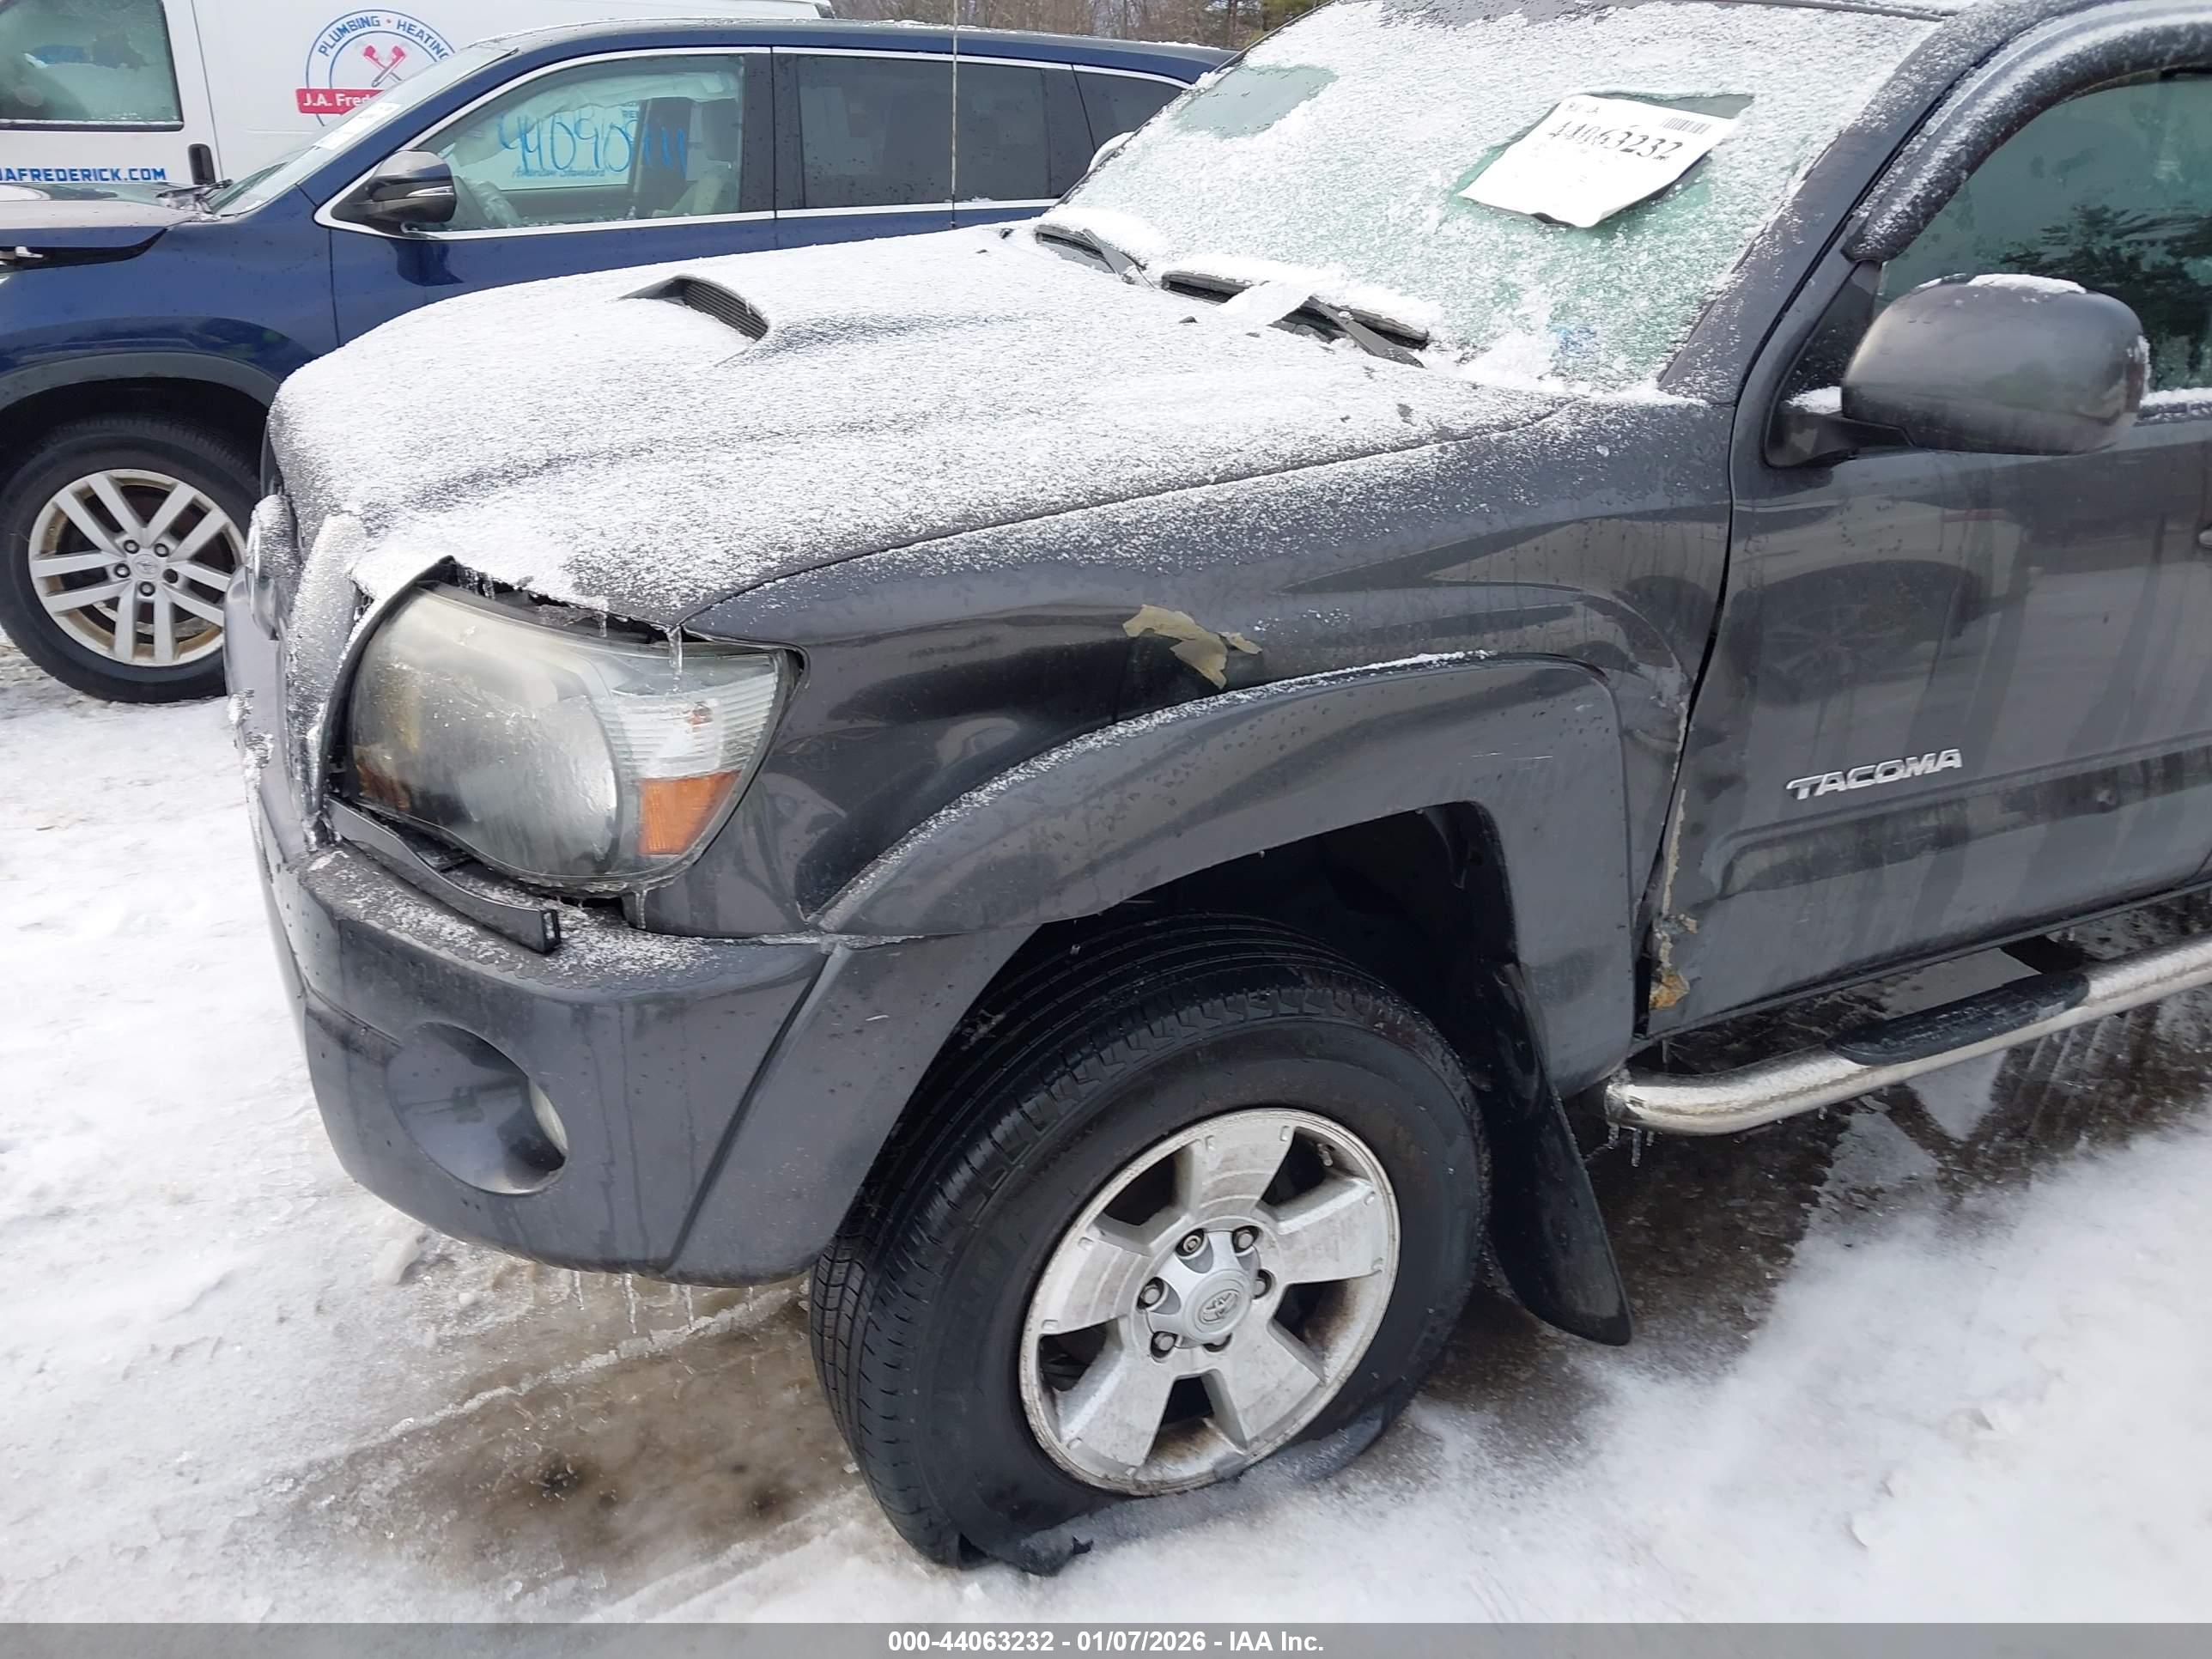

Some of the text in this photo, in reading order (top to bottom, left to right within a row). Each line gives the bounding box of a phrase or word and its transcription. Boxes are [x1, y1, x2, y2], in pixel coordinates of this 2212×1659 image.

[318, 15, 380, 57] PLUMBING
[302, 93, 333, 107] J.A.
[1785, 748, 1963, 800] TACOMA
